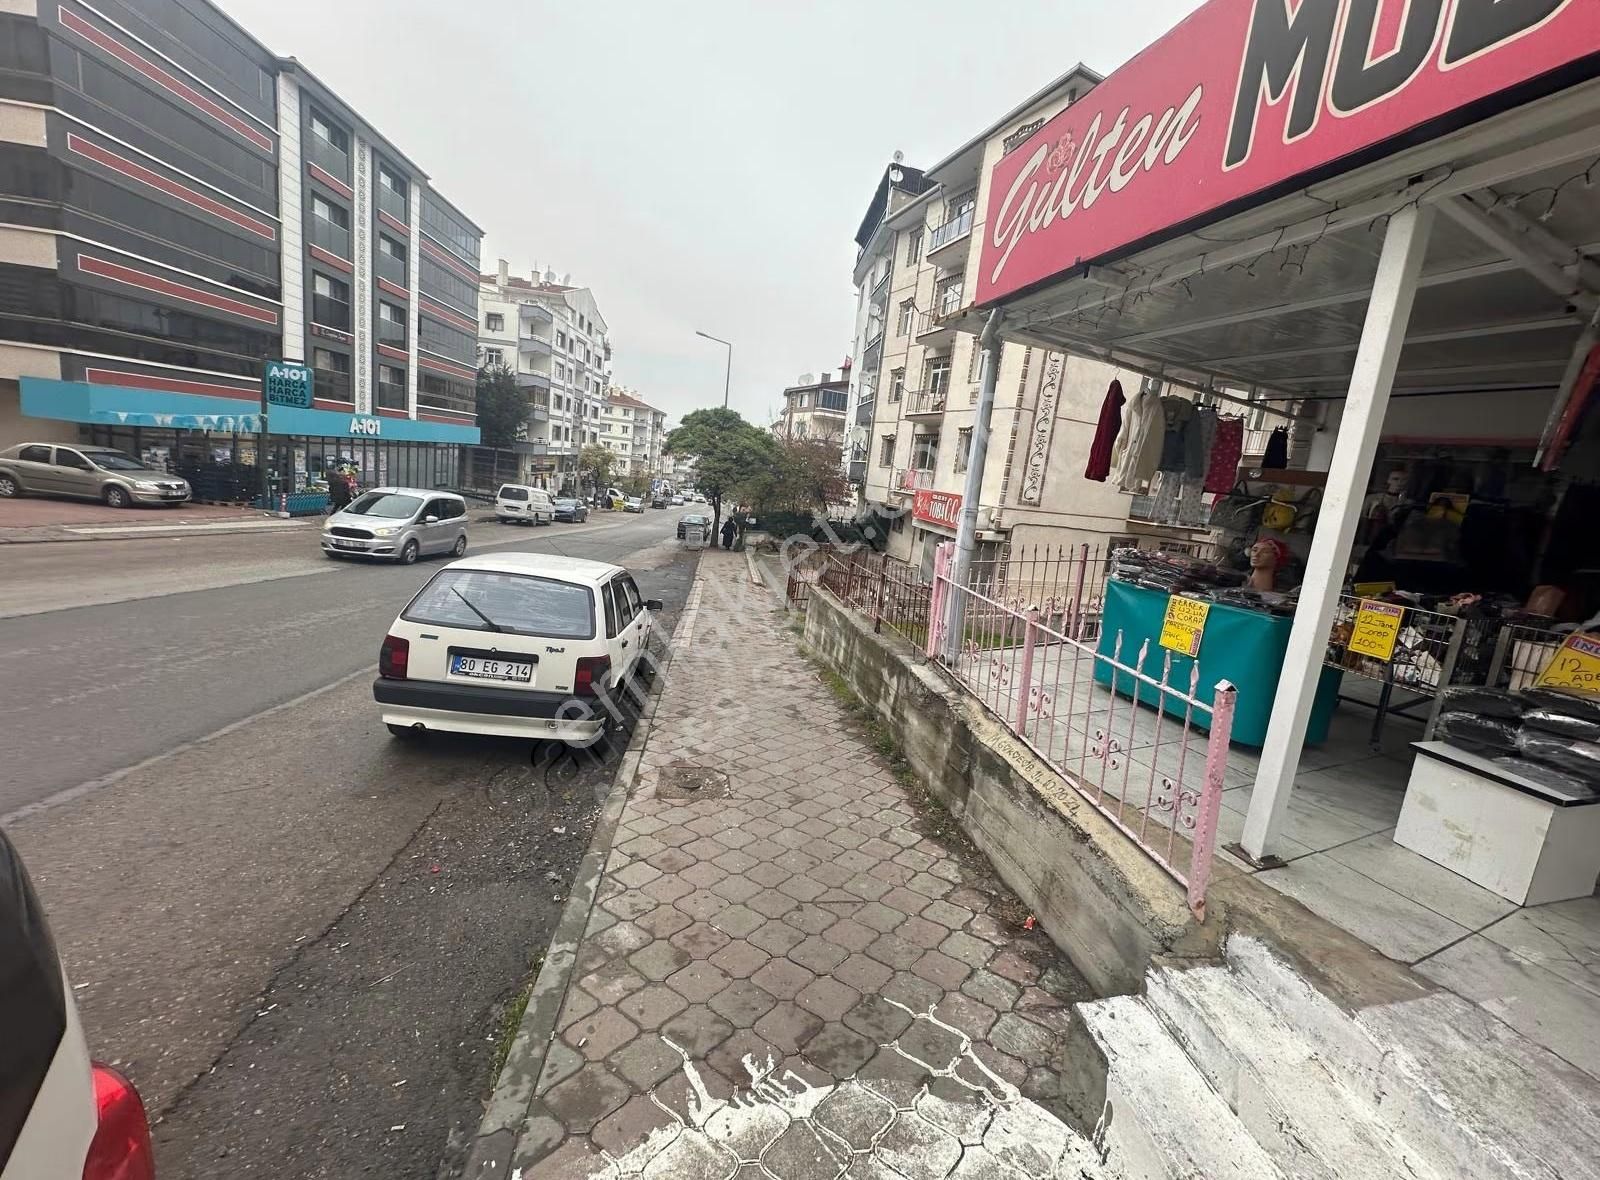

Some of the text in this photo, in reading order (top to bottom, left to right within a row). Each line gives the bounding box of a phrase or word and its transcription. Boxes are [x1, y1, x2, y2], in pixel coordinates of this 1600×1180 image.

[268, 378, 306, 390] HARCA
[268, 385, 306, 398] HARCA
[460, 658, 476, 672] 80
[483, 661, 499, 674] EG
[505, 663, 529, 677] 214
[1560, 657, 1592, 673] 12
